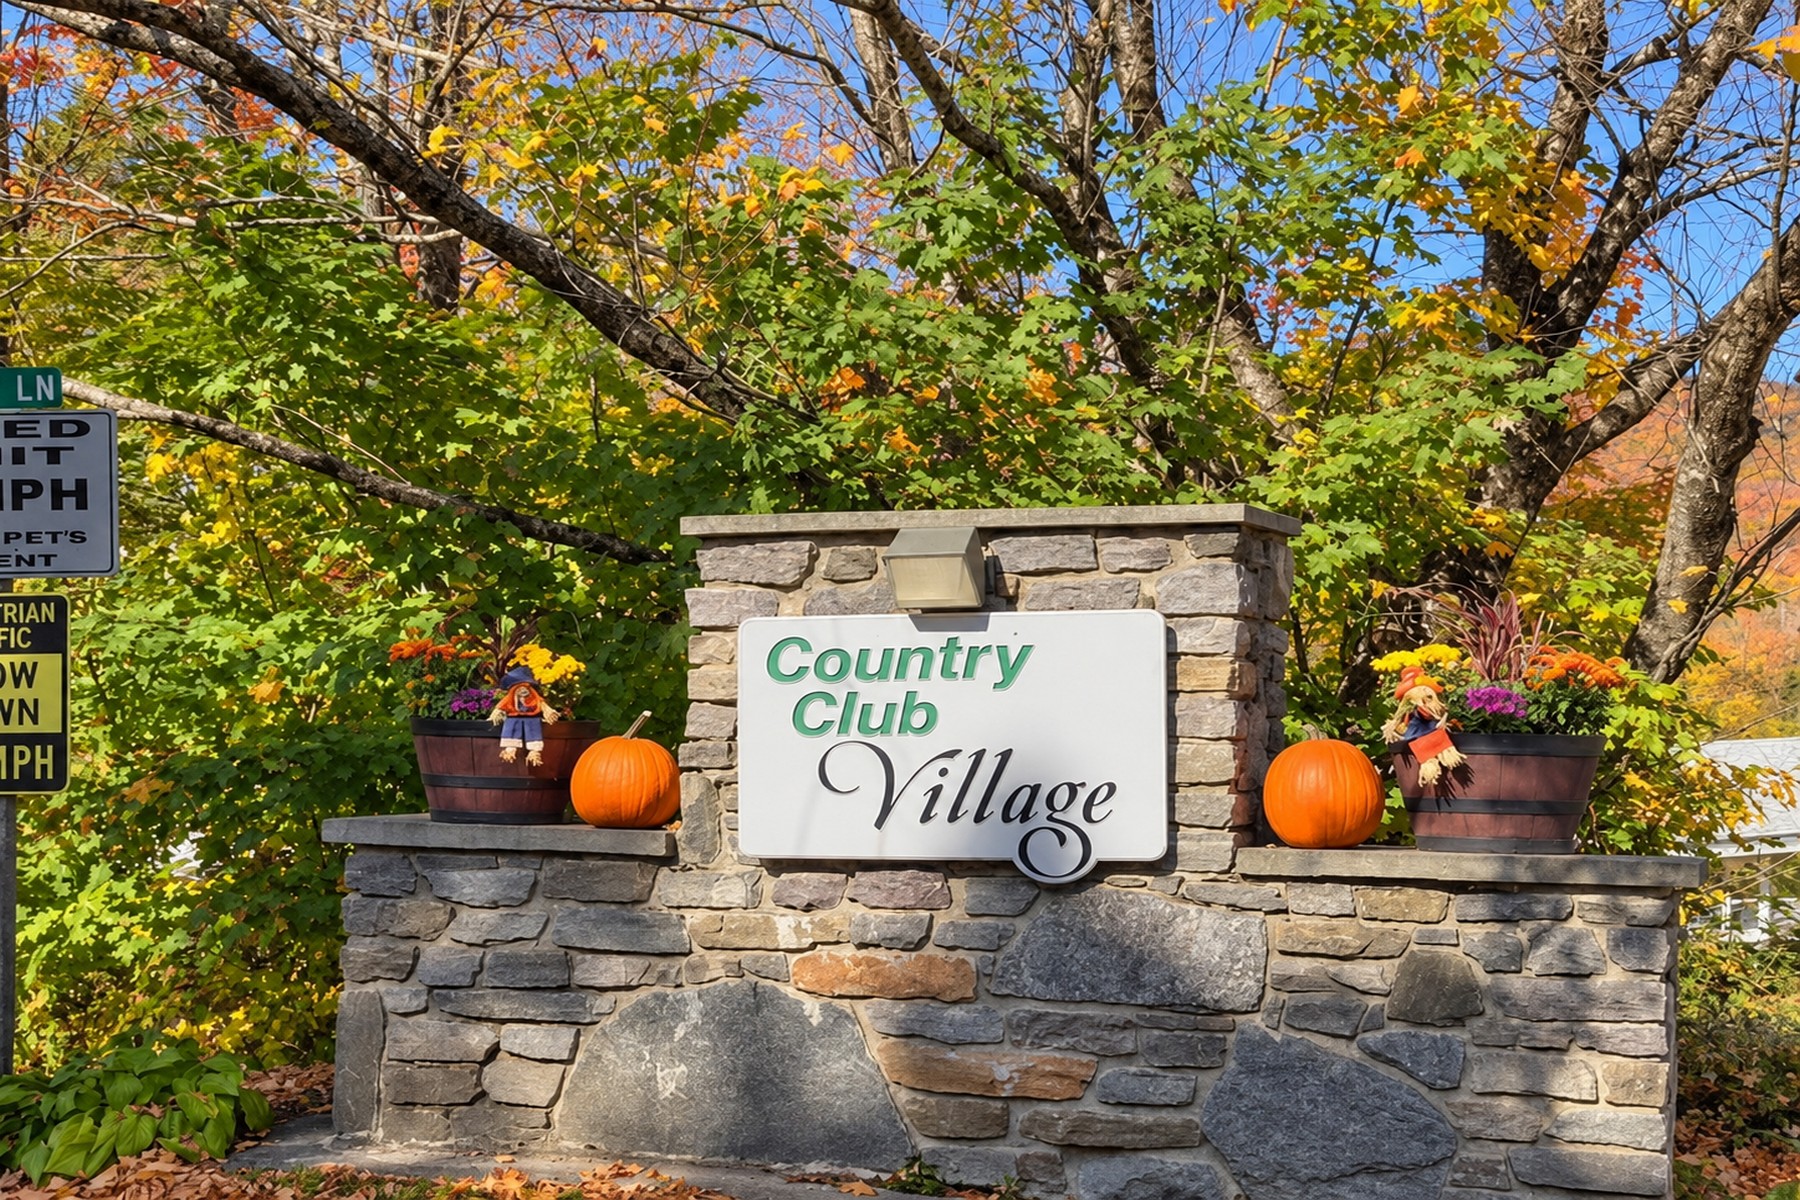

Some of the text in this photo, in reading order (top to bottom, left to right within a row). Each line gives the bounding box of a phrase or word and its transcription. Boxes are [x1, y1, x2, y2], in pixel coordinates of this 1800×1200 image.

[17, 375, 55, 401] LN
[3, 420, 91, 438] ED
[0, 446, 74, 465] IT
[0, 478, 88, 511] PH
[4, 530, 87, 544] PET'S
[0, 602, 55, 623] RIAN
[0, 661, 38, 689] W
[766, 636, 1035, 691] Country
[791, 691, 939, 737] Club
[0, 745, 53, 779] PH
[818, 740, 1117, 877] Village
